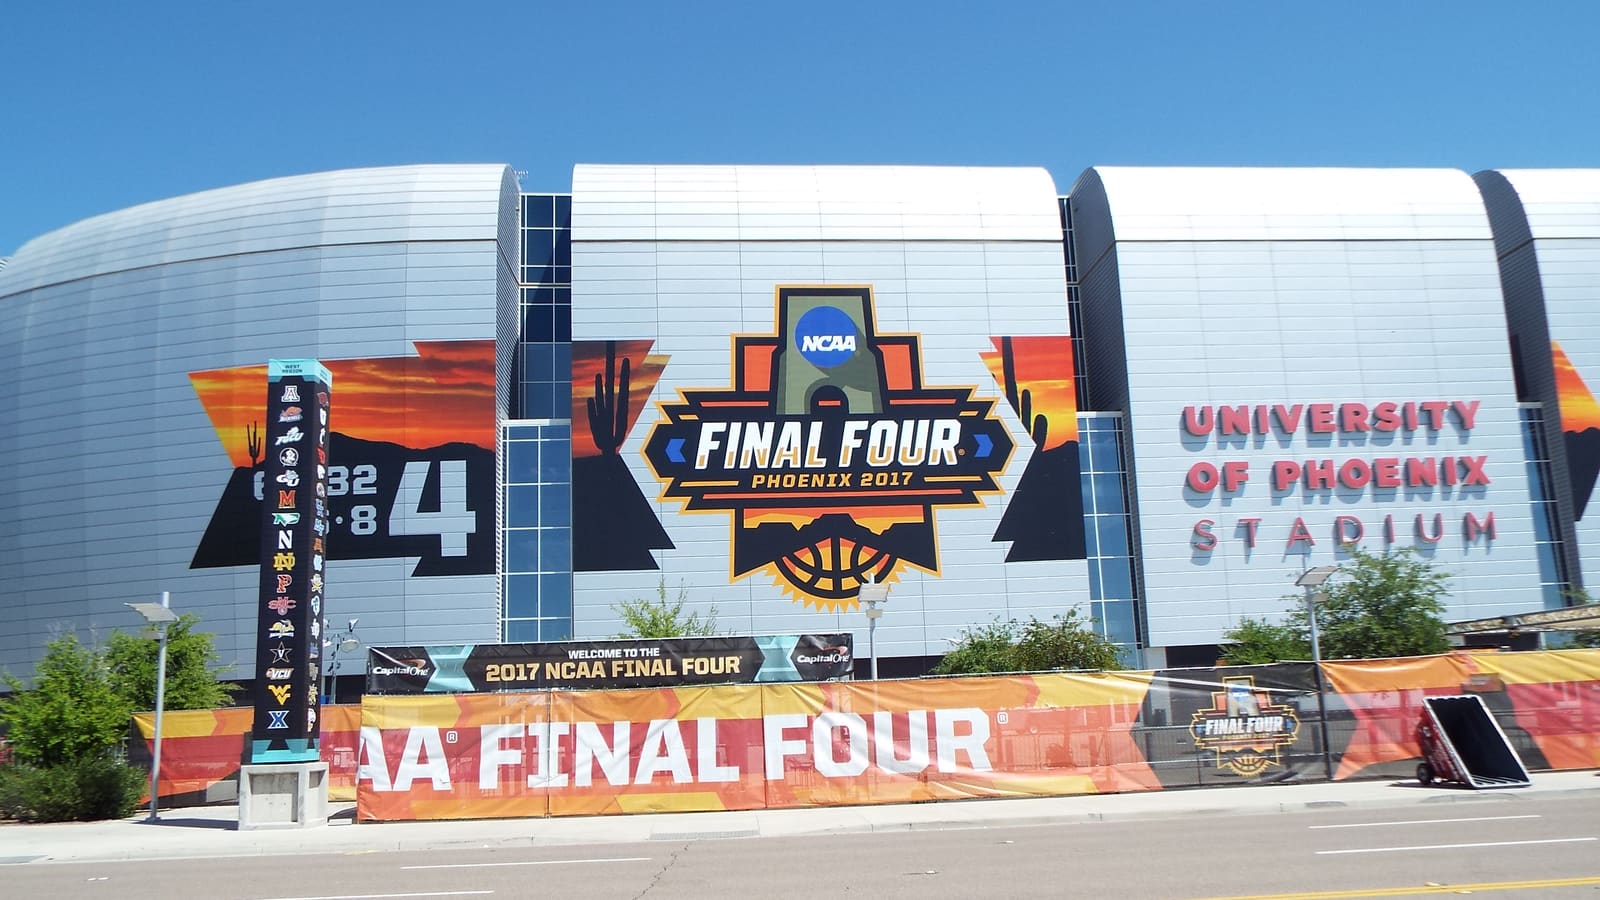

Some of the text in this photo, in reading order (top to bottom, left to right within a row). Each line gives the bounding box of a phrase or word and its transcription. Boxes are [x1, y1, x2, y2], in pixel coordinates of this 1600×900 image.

[802, 335, 856, 352] NCAA
[1184, 401, 1481, 435] UNIVERSITY
[695, 418, 963, 470] FINAL FOUR
[751, 471, 914, 489] PHOENIX 2017
[1187, 455, 1491, 493] OF PHOENIX
[389, 459, 476, 557] 4
[278, 529, 293, 549] N
[1193, 511, 1497, 551] STADIUM
[486, 655, 742, 682] 2017 NCAA FINAL FOUR
[568, 647, 660, 660] WELCOME TO THE
[1205, 716, 1284, 735] FINAL FOUR
[479, 717, 740, 790] FINAL
